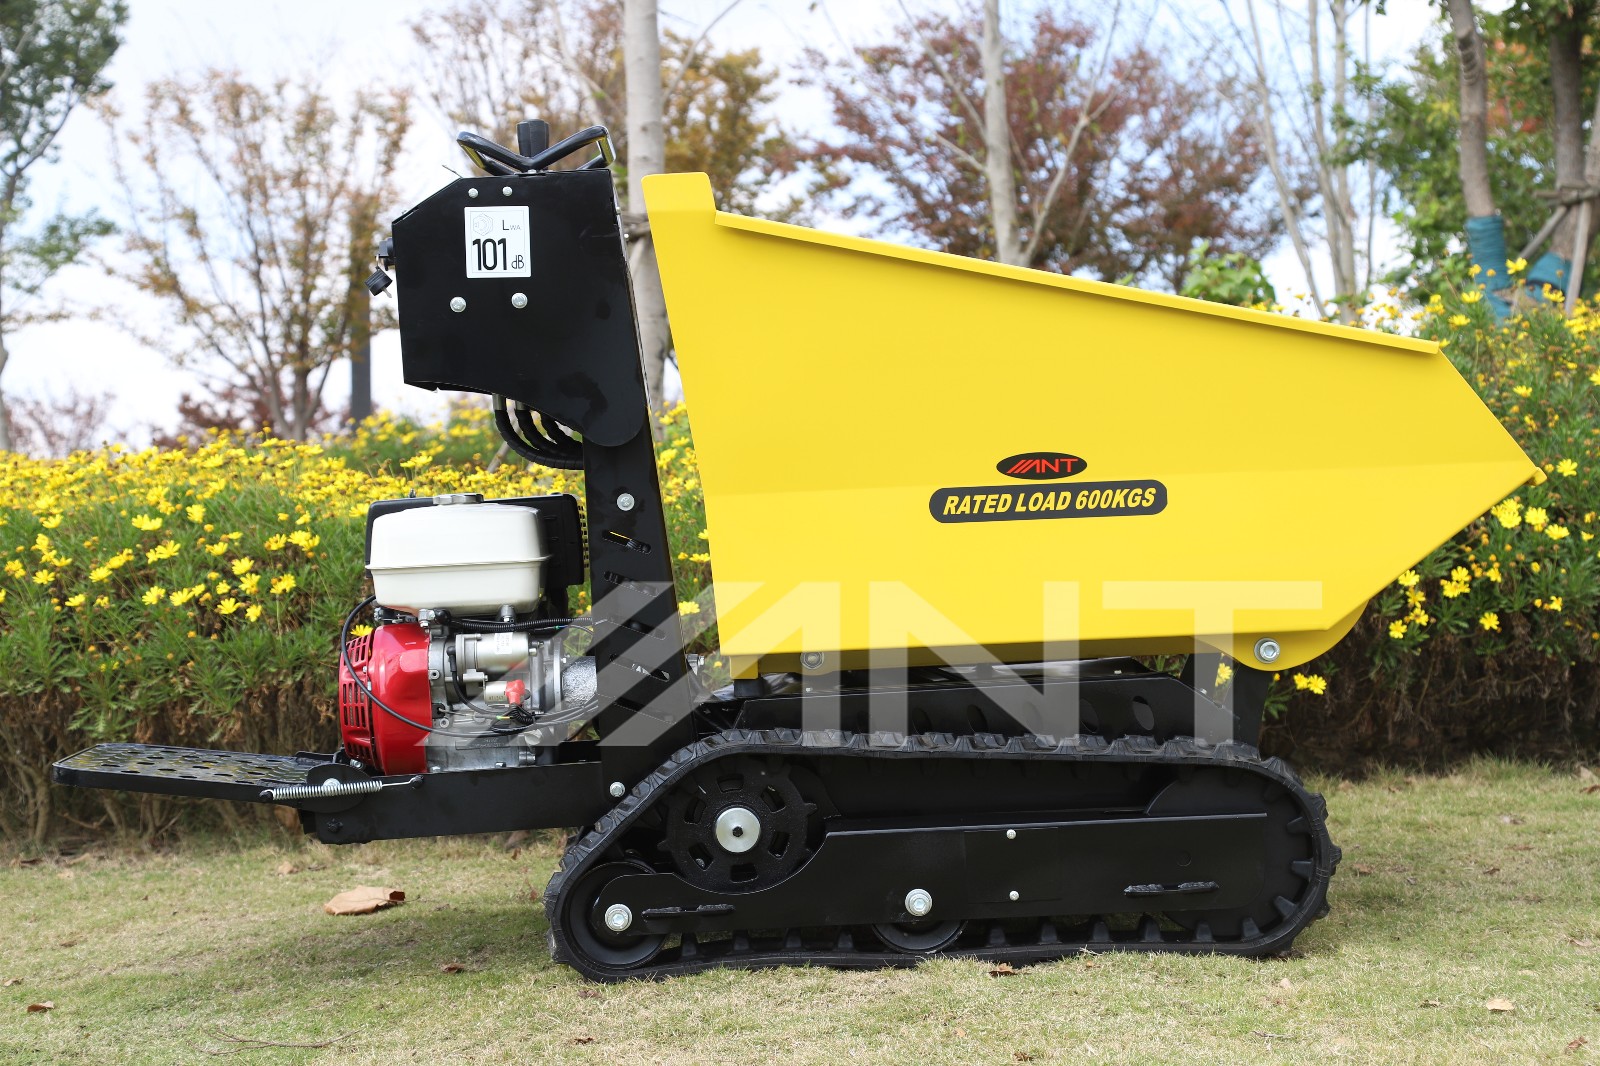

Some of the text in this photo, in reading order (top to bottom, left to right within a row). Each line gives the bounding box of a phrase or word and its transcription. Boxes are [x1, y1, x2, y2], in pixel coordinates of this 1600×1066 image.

[472, 238, 525, 271] 101 dB
[1006, 458, 1079, 474] ANT
[943, 487, 1157, 515] RATED LOAD 600KGS
